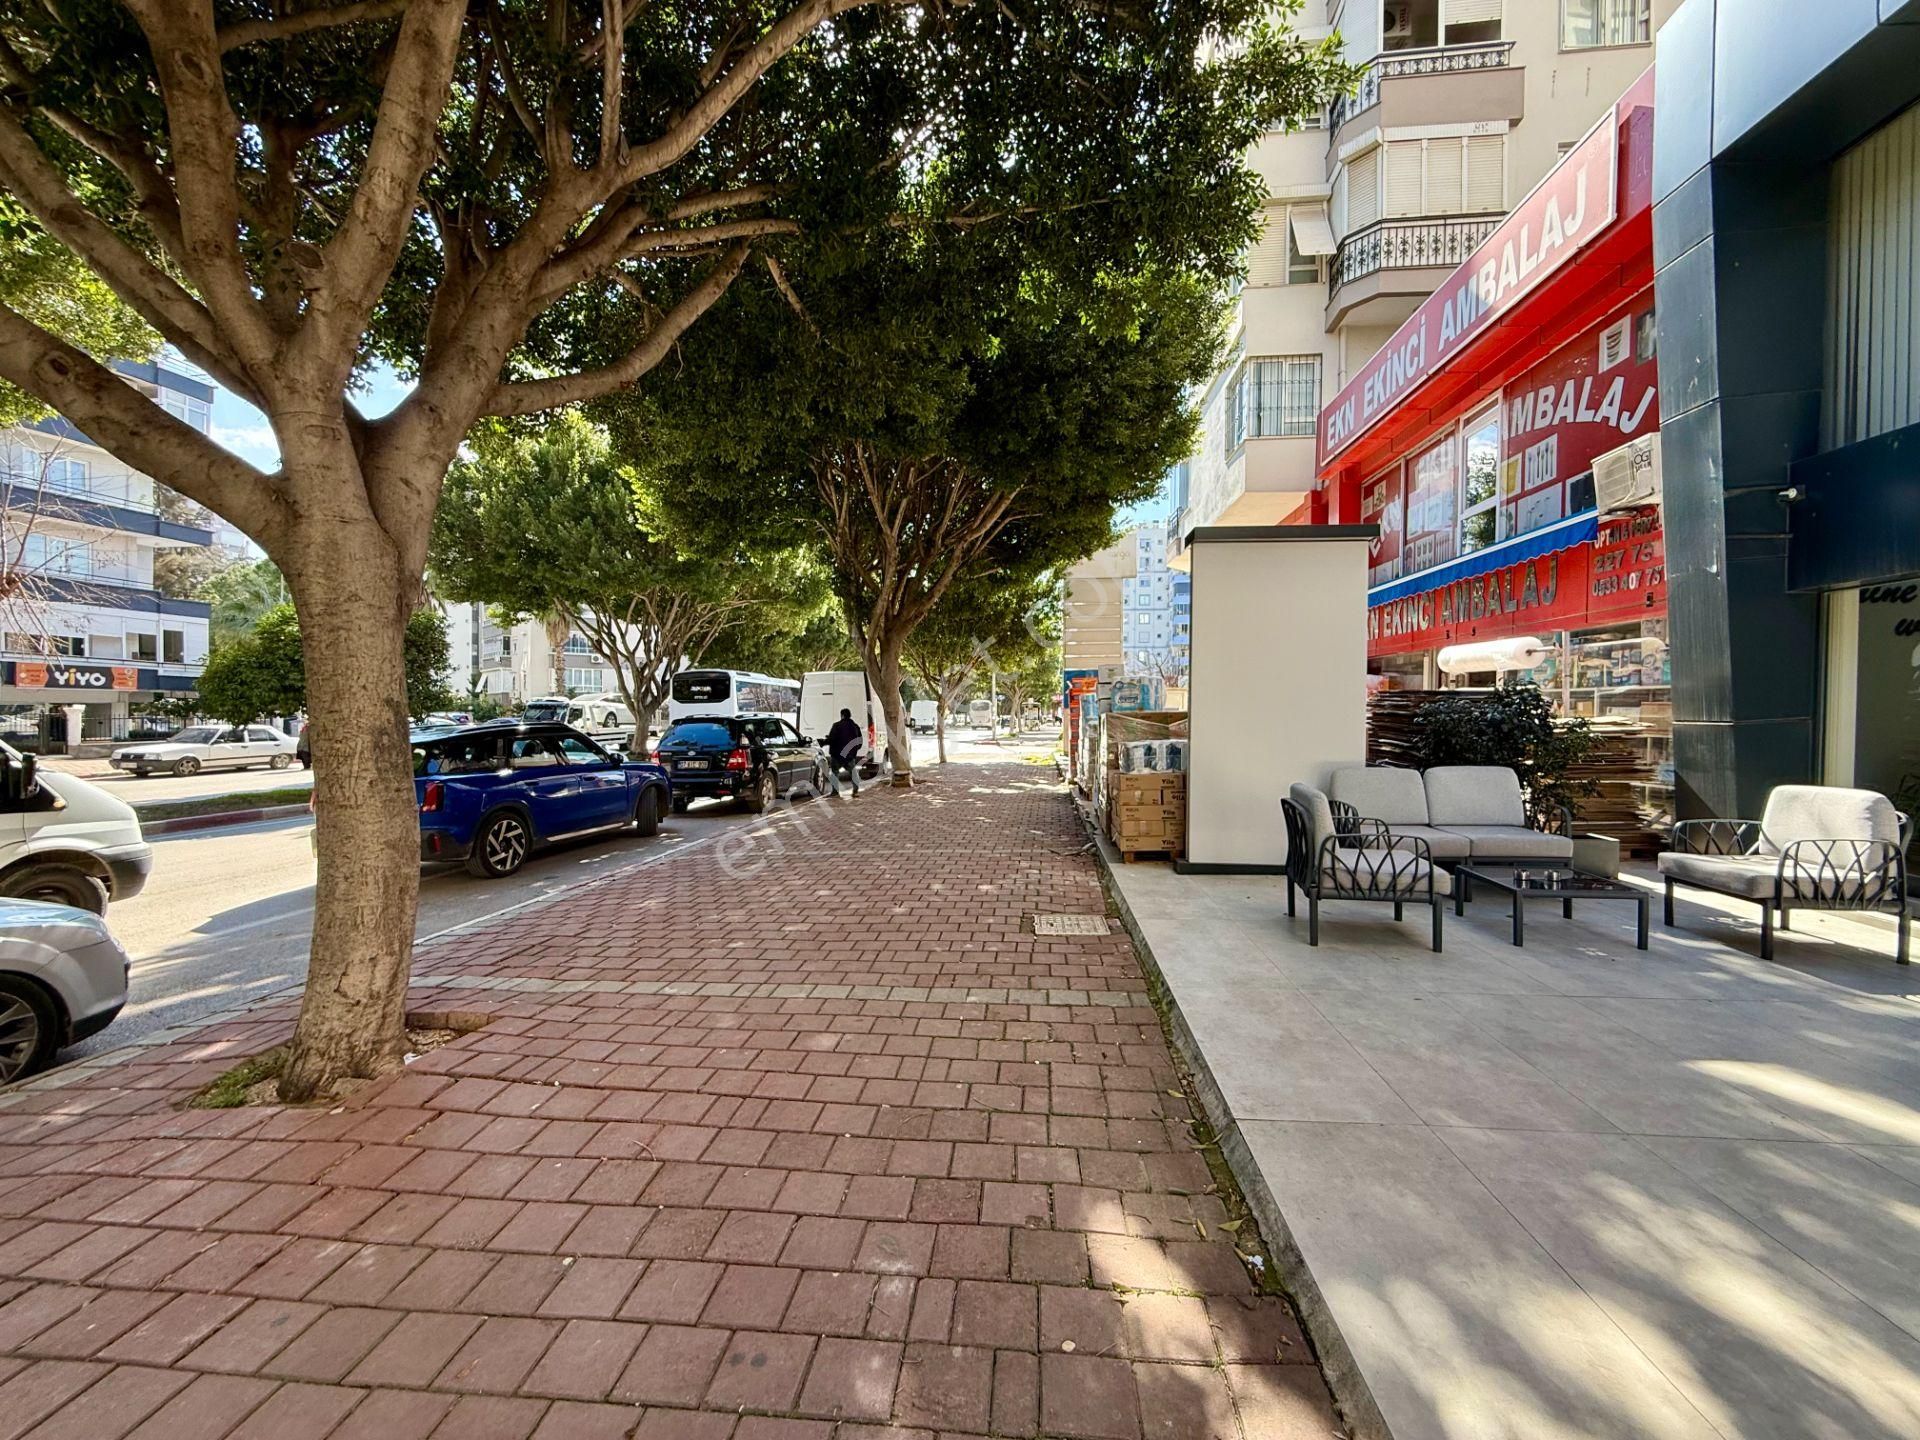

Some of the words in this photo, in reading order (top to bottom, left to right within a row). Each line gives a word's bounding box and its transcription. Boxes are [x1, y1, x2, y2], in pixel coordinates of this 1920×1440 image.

[1327, 391, 1355, 450] EKN
[1363, 313, 1426, 420] EKİNCİ
[1438, 163, 1588, 352] AMBALAJ
[1441, 555, 1558, 626] AMBALAJ
